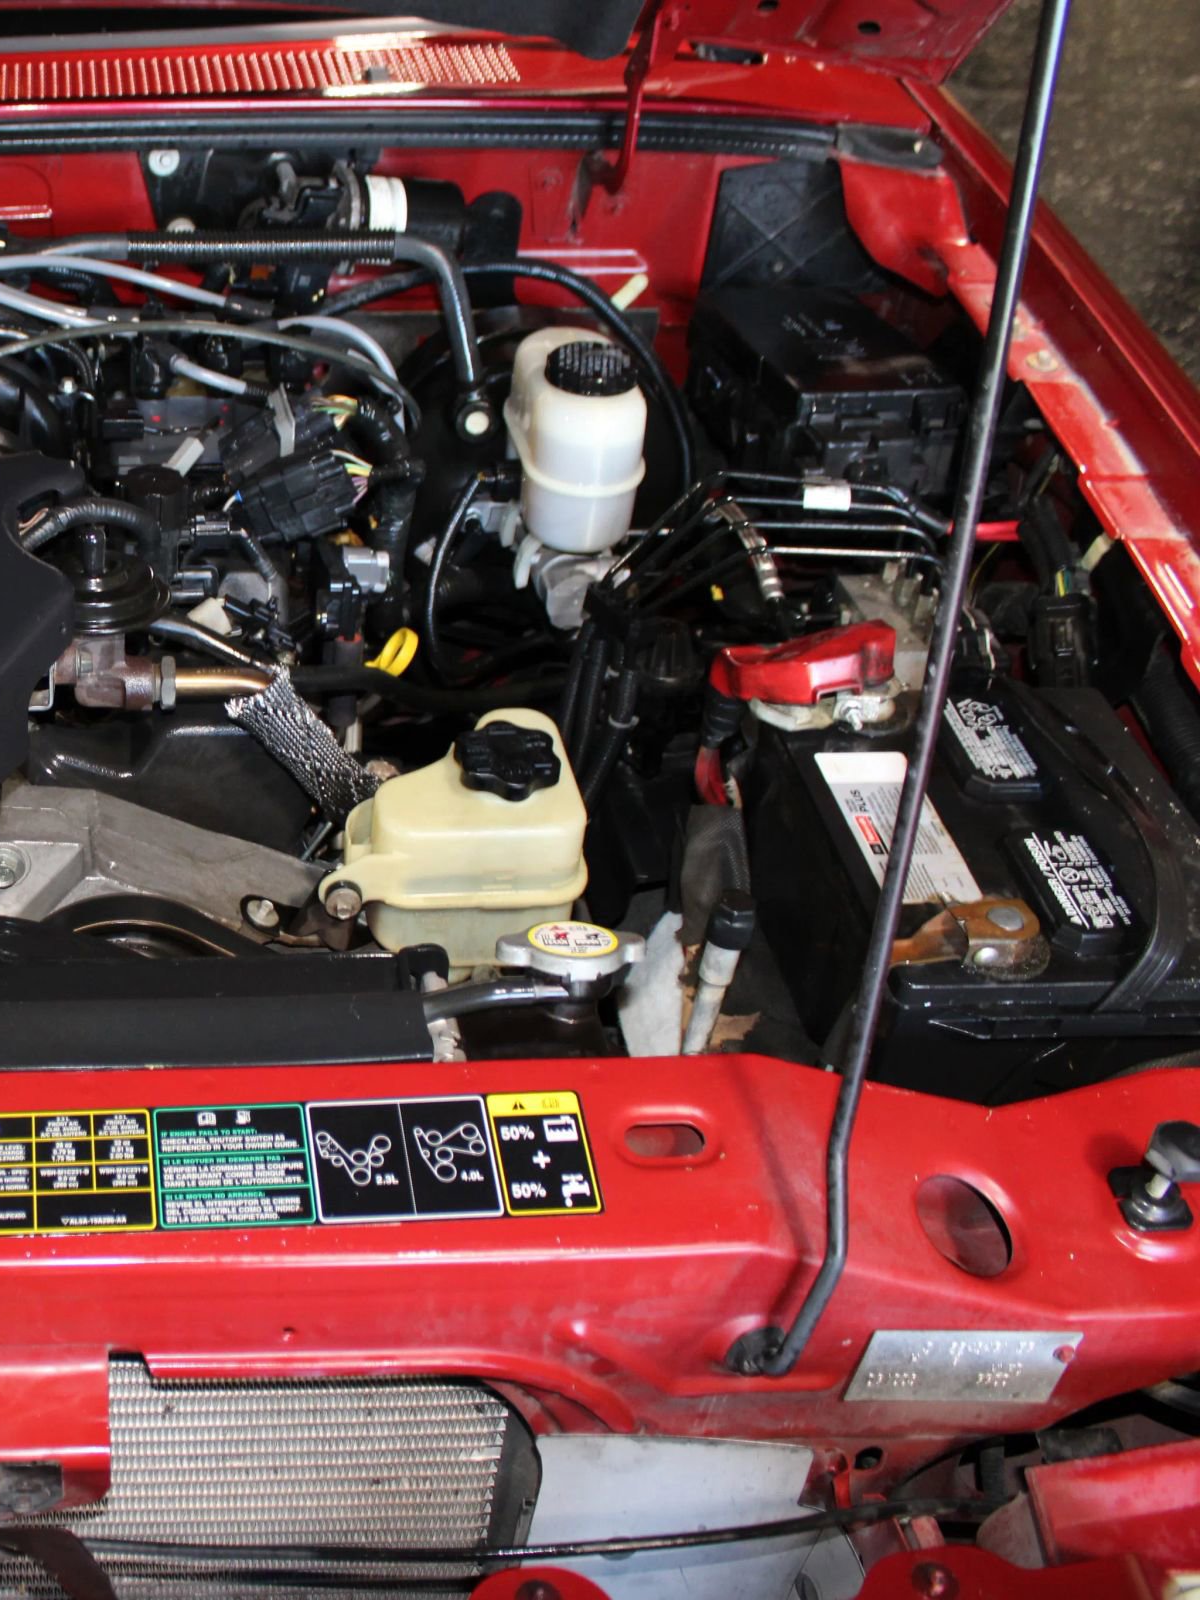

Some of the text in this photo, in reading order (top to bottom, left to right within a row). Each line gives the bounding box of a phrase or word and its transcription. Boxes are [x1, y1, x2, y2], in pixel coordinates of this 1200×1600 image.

[500, 1125, 535, 1141] 50%
[161, 1134, 285, 1146] CHECK FUEL SHUTOFF SWITCH AS
[162, 1144, 211, 1153] REFERENCED
[214, 1143, 221, 1151] IN
[222, 1143, 244, 1151] YOUR
[245, 1142, 273, 1150] OWNER
[199, 1165, 209, 1173] LA
[210, 1163, 253, 1173] COMMANDE
[256, 1163, 266, 1171] DE
[267, 1162, 304, 1171] COUPURE
[225, 1171, 253, 1179] COMME
[375, 1174, 399, 1186] 2.3L
[460, 1171, 484, 1182] 4.0L
[164, 1180, 185, 1188] DANS
[198, 1179, 221, 1187] GUIDE
[511, 1183, 547, 1199] 50%
[165, 1197, 300, 1209] REVISE EL INTERRUPTOR DE CIERRE
[166, 1205, 273, 1216] DEL COMBUSTIBLE COMO SE
[167, 1216, 177, 1224] EN
